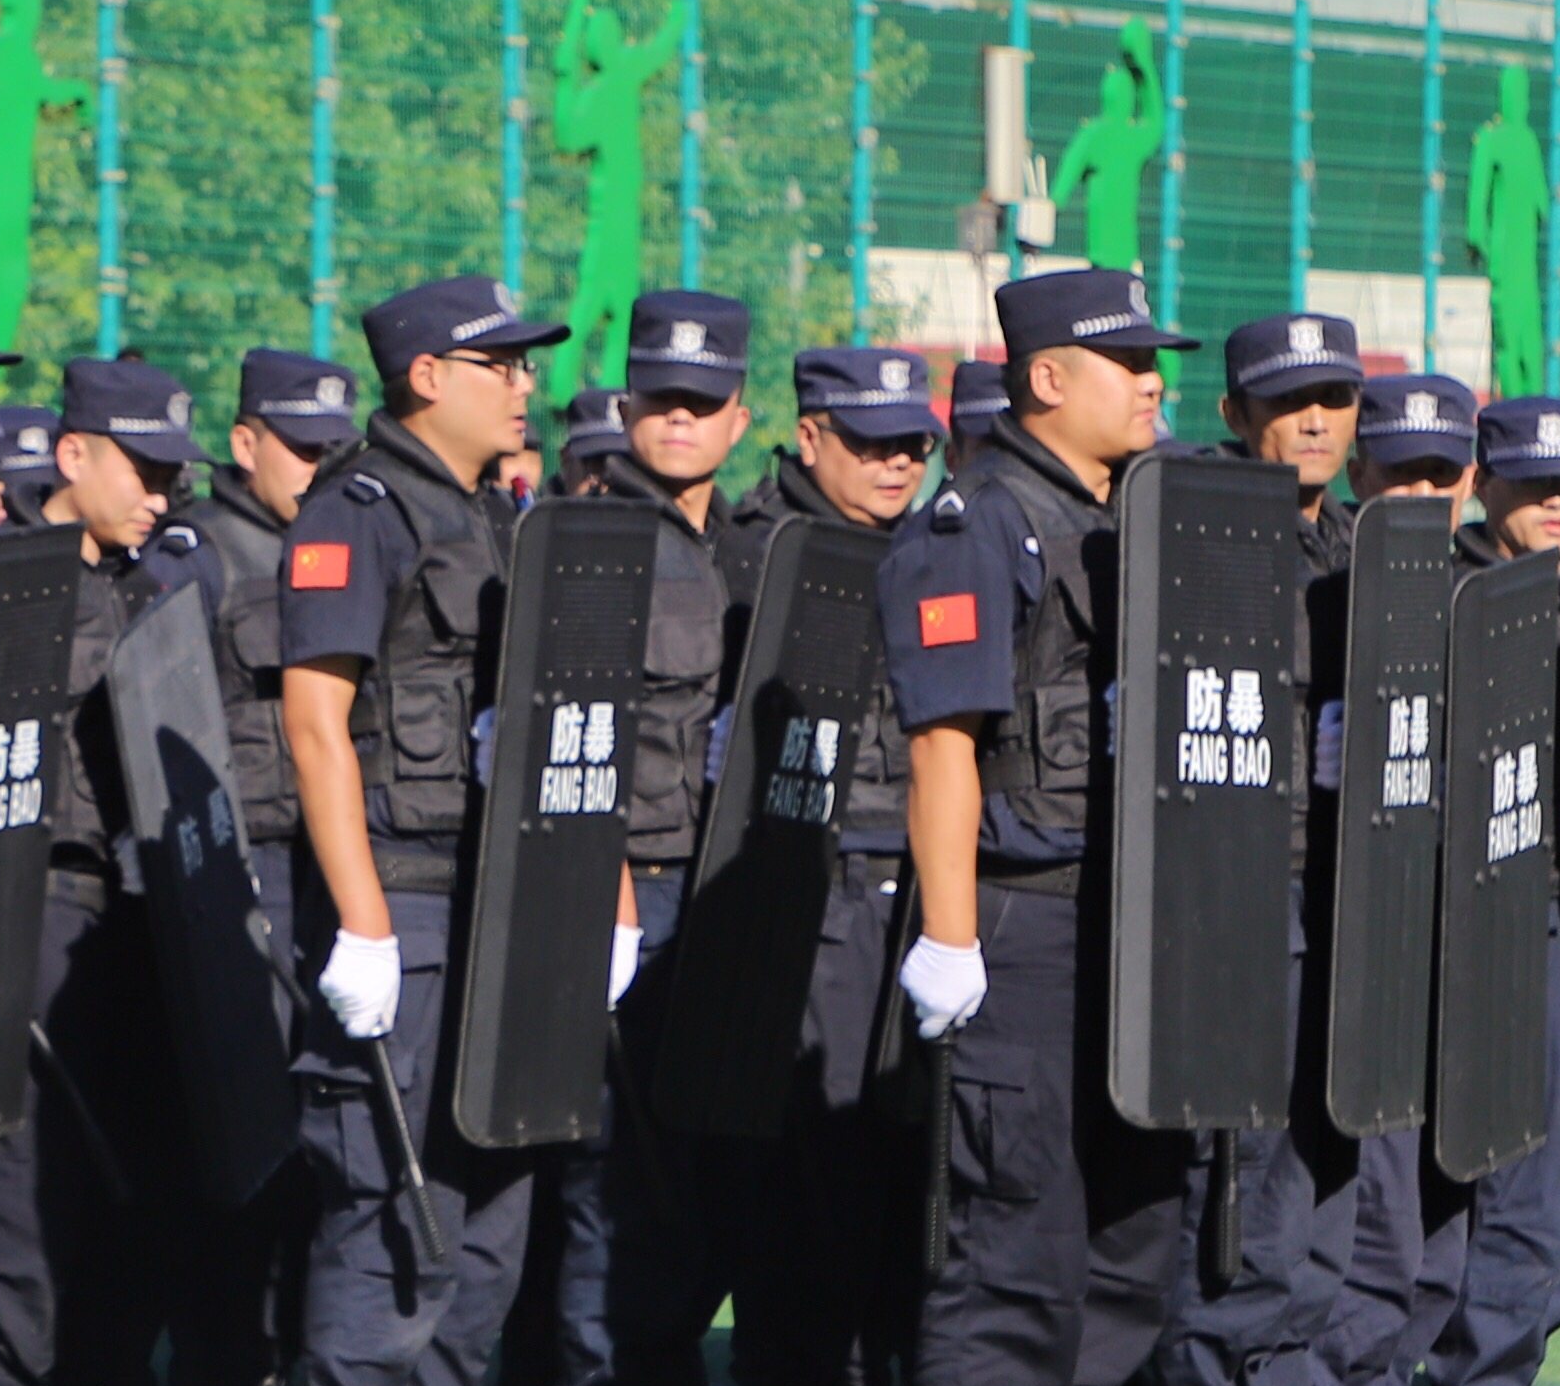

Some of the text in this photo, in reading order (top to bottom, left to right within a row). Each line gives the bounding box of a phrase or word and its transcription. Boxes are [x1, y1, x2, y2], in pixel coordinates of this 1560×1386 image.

[1186, 666, 1264, 734] 防暴
[1388, 695, 1430, 758] 防暴
[550, 701, 615, 764] 防暴
[780, 715, 840, 777] 防暴
[1178, 732, 1272, 788] FANG BAO
[8, 778, 42, 827] BAO
[539, 764, 617, 814] FANG BAO
[1383, 757, 1431, 807] FANG BAO
[1493, 742, 1538, 814] 防暴
[1488, 799, 1542, 863] FANG BAO
